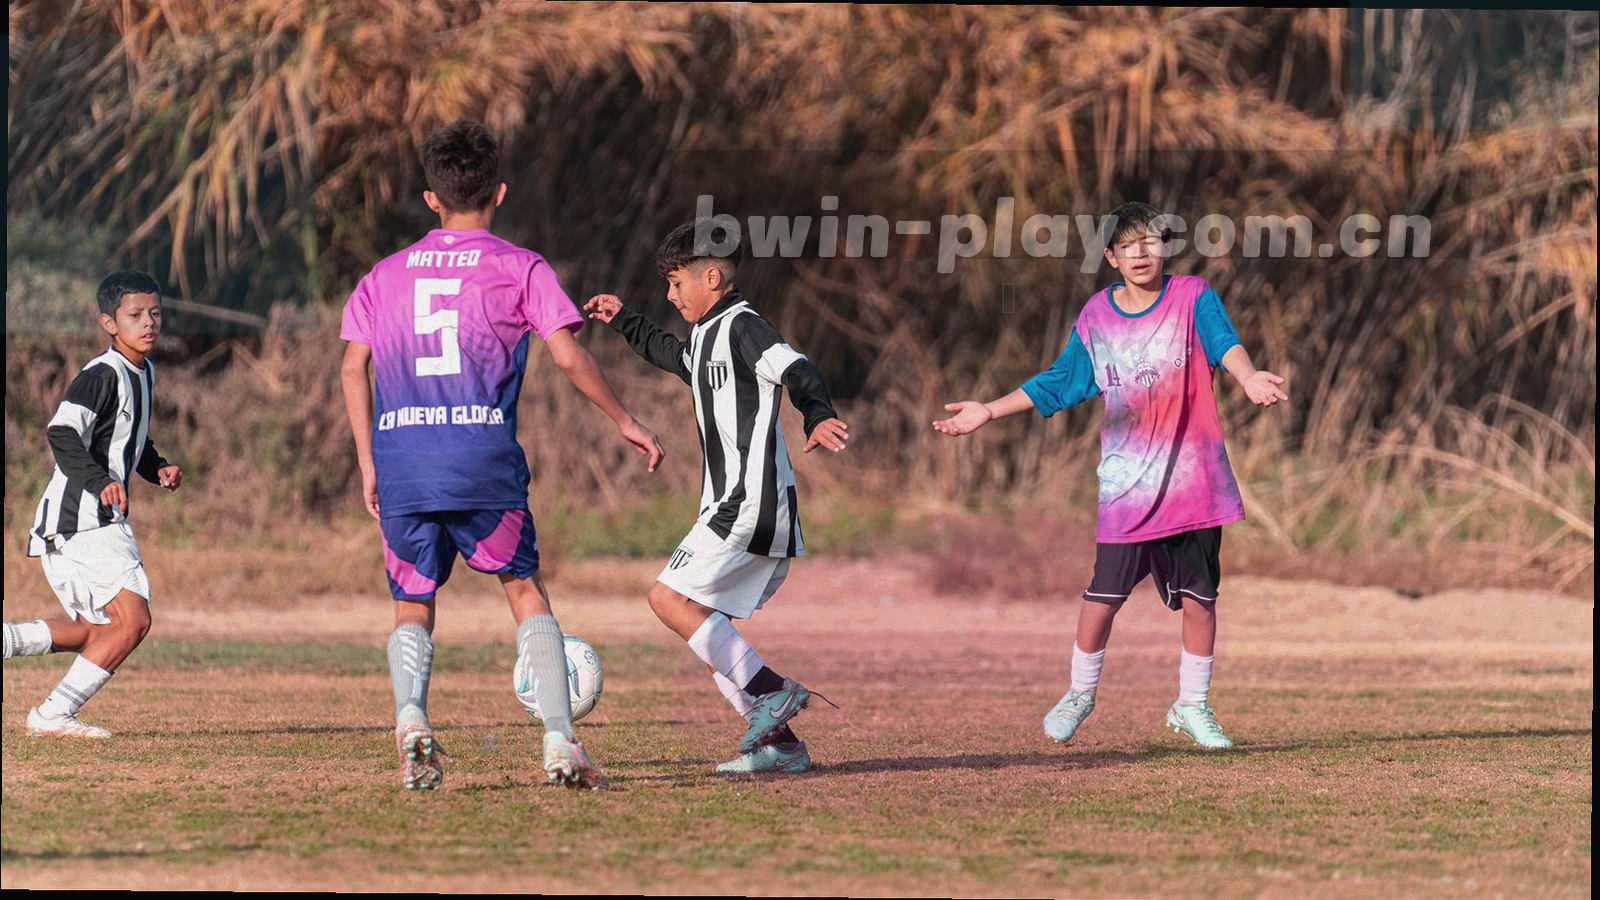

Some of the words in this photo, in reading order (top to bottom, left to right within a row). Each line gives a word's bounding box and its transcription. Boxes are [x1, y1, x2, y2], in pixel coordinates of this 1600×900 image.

[406, 249, 481, 268] MATTEO
[414, 278, 461, 376] 5
[1105, 363, 1122, 387] 14
[378, 411, 396, 430] LA
[396, 406, 447, 428] NUEVA
